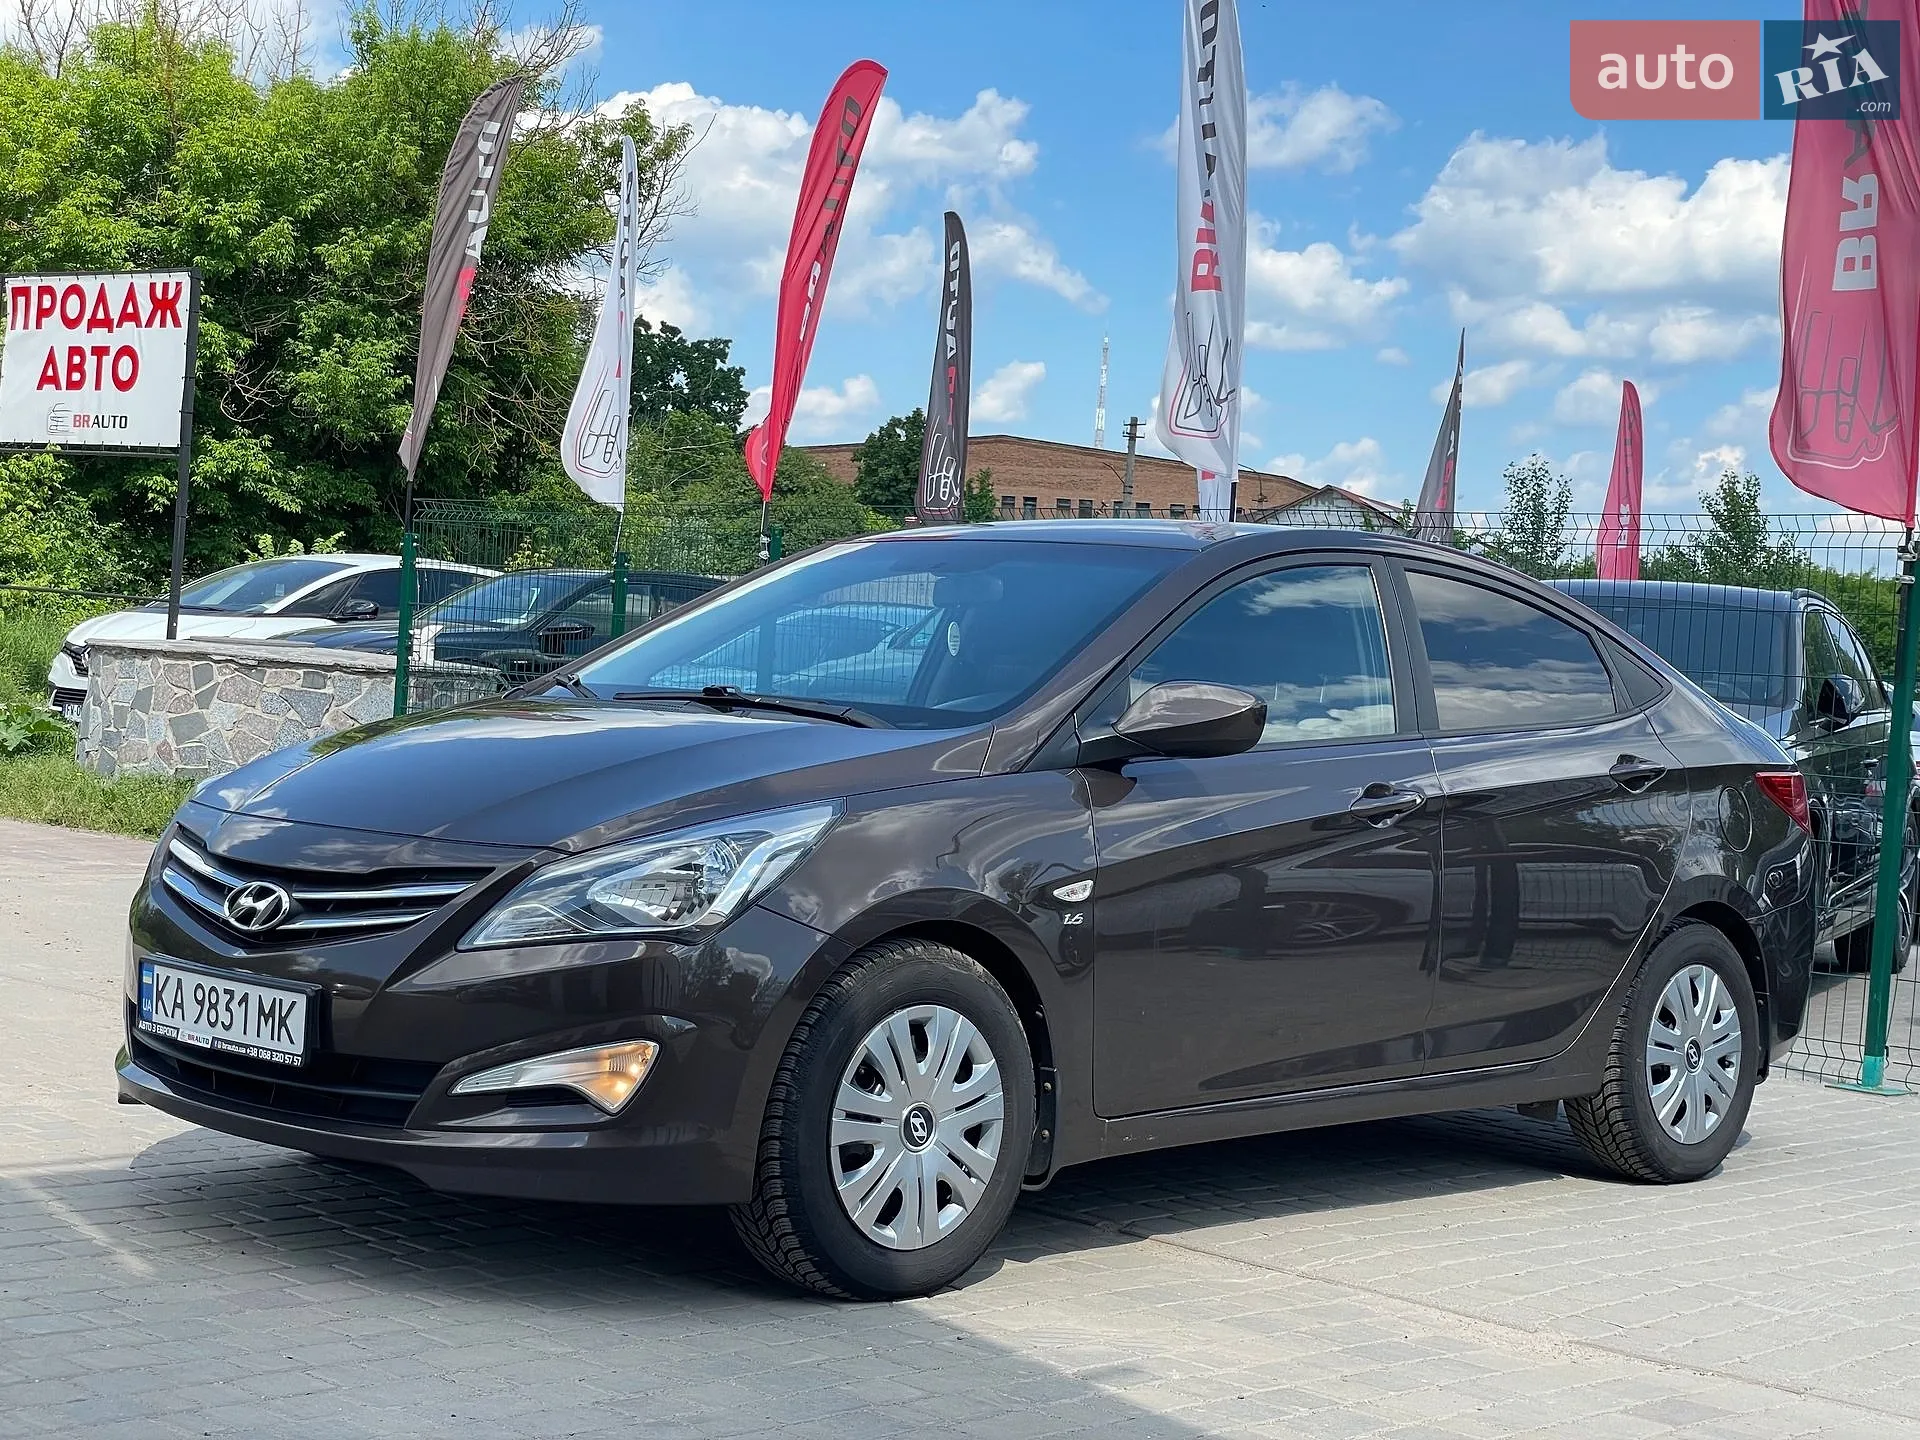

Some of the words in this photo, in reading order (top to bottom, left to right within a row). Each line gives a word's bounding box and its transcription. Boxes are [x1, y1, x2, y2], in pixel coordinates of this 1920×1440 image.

[10, 281, 183, 334] ПРОДАЖ
[36, 345, 140, 393] АВТО
[72, 414, 128, 429] BRAUTO
[142, 998, 152, 1012] UA
[155, 972, 186, 1021] KA
[193, 982, 249, 1035] 9831
[257, 993, 298, 1045] MK
[187, 1033, 210, 1045] BRAUTO
[285, 1054, 293, 1064] 57
[293, 1056, 302, 1066] 57
